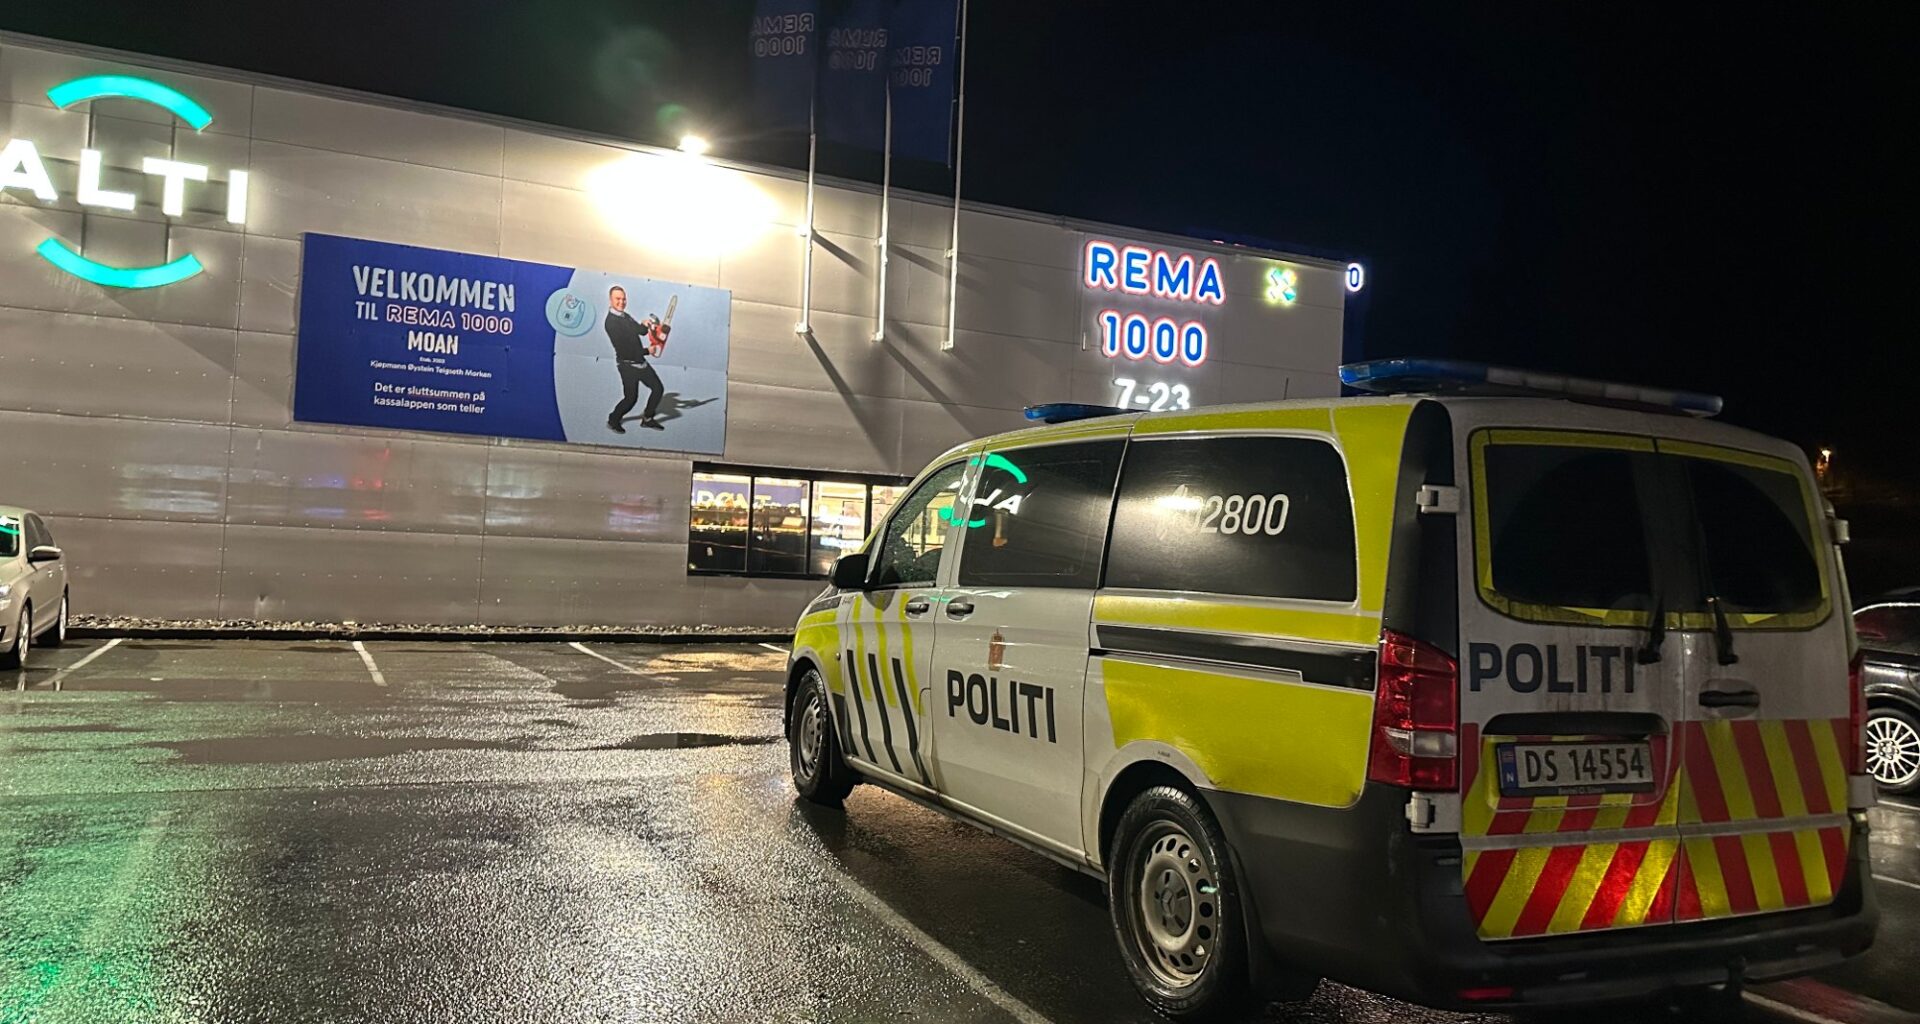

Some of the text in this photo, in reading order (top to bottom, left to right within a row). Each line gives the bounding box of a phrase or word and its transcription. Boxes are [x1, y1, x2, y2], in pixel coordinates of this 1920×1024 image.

[0, 138, 248, 224] ALTI
[352, 265, 515, 312] VELKOMMEN
[1088, 243, 1224, 303] REMA
[355, 301, 513, 335] TIL REMA 1000
[407, 330, 459, 355] MOAN
[1102, 311, 1206, 365] 1000
[370, 360, 406, 370] Kjøpmann
[408, 363, 434, 373] Øystein
[373, 395, 486, 414] kassalappen som teller
[374, 382, 486, 402] Det er sluttsummen på
[1114, 377, 1191, 412] 7-23
[1469, 642, 1635, 693] POLITI
[947, 669, 1057, 744] POLITI
[1525, 750, 1558, 782] DS
[1568, 747, 1644, 781] 14554
